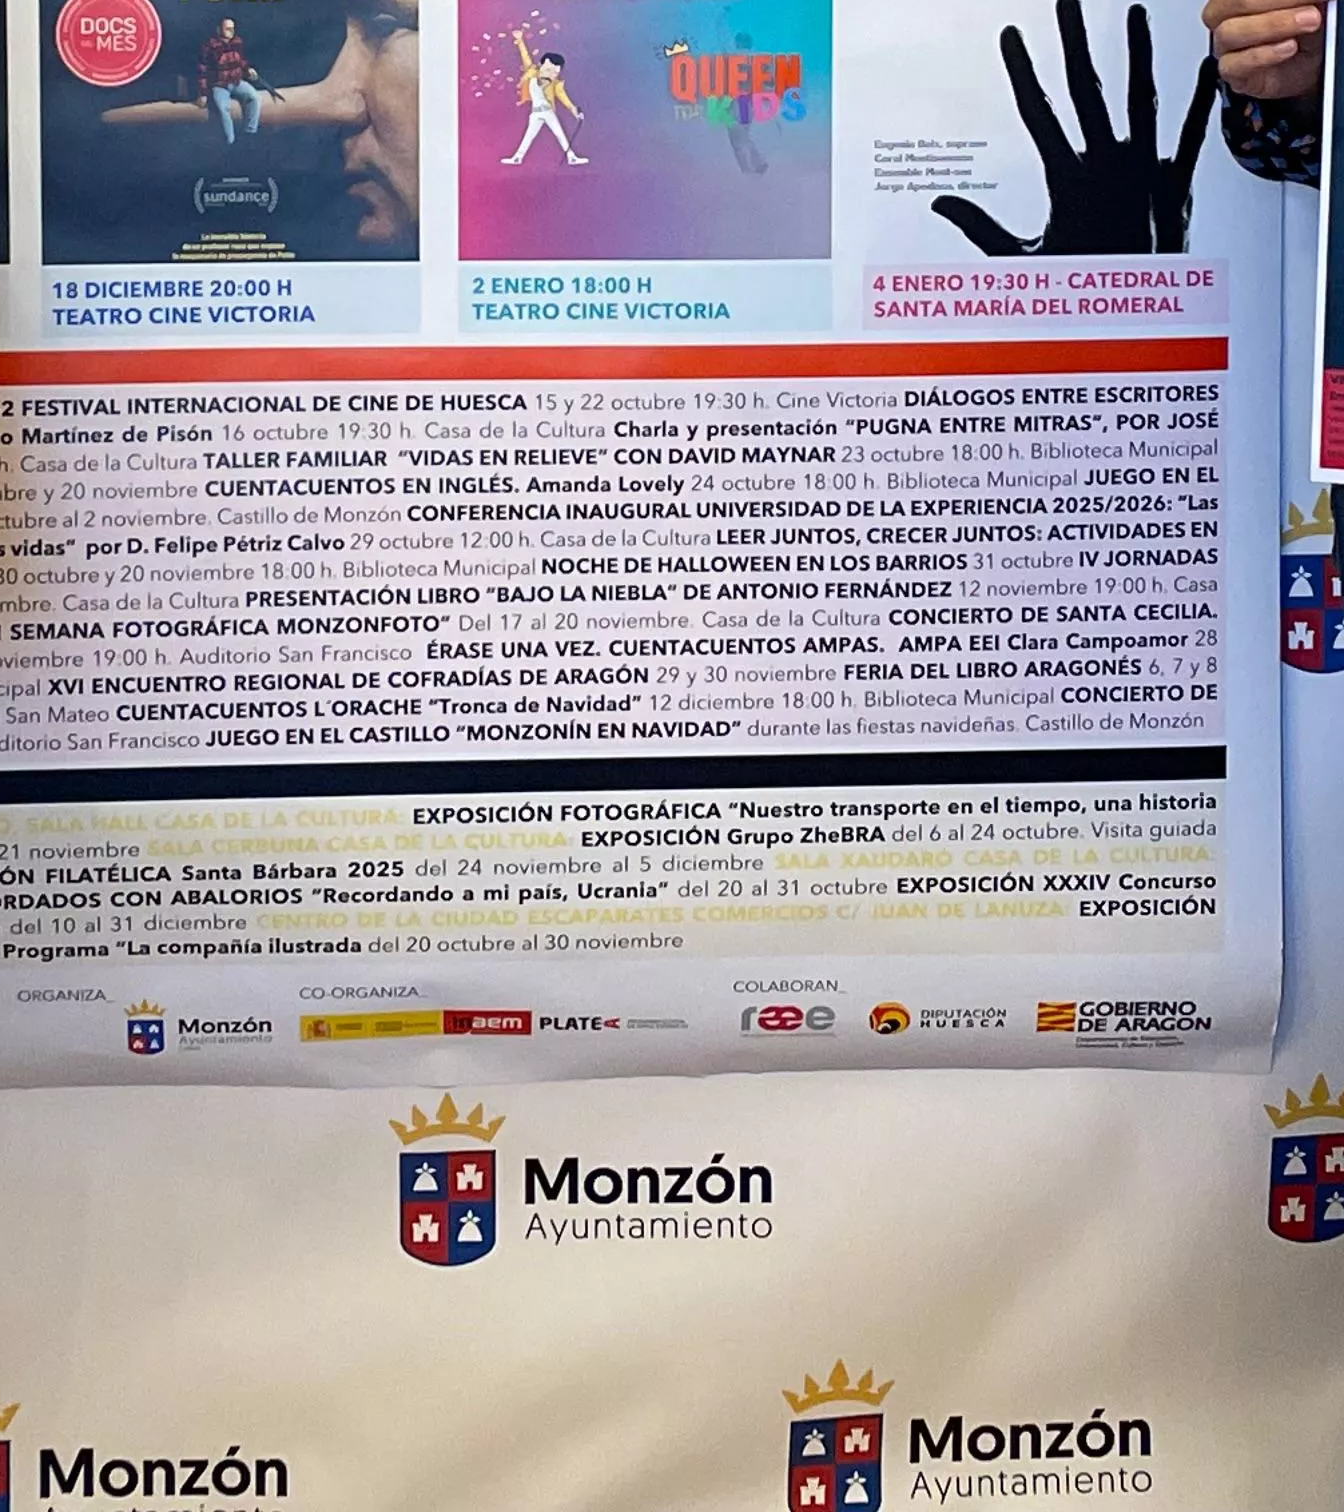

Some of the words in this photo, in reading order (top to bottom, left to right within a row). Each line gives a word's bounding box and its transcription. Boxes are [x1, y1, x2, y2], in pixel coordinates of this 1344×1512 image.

[204, 191, 269, 202] sundance
[874, 276, 885, 291] 4
[893, 275, 962, 291] ENERO
[972, 274, 1028, 290] 19:30
[1036, 274, 1048, 288] H
[1068, 271, 1179, 288] CATEDRAL
[1187, 270, 1213, 286] DE
[875, 301, 947, 317] SANTA
[955, 298, 1025, 316] MARÍA
[1033, 299, 1072, 314] DEL
[1079, 297, 1184, 314] ROMERAL
[22, 399, 120, 416] FESTIVAL
[128, 397, 305, 414] INTERNACIONAL
[314, 396, 340, 411] DE
[349, 396, 397, 411] CINE
[406, 396, 433, 410] DE
[442, 395, 527, 410] HUESCA
[905, 386, 1014, 406] DIÁLOGOS
[1023, 387, 1088, 404] ENTRE
[1095, 384, 1219, 403] ESCRITORES
[615, 421, 678, 437] Charla
[688, 426, 698, 441] y
[707, 420, 836, 441] presentación
[614, 449, 661, 464] CON
[669, 448, 735, 464] DAVID
[743, 447, 835, 463] MAYNAR
[1032, 443, 1122, 459] Biblioteca
[1130, 438, 1217, 460] Municipal
[567, 503, 691, 519] INAUGURAL
[697, 501, 840, 518] UNIVERSIDAD
[847, 501, 874, 516] DE
[881, 501, 905, 516] LA
[911, 498, 1048, 516] EXPERIENCIA
[1053, 496, 1172, 513] 2025/2026:
[542, 558, 618, 574] NOCHE
[625, 558, 651, 573] DE
[659, 556, 790, 572] HALLOWEEN
[797, 556, 824, 571] EN
[831, 556, 870, 571] LOS
[877, 554, 967, 570] BARRIOS
[889, 608, 1012, 625] CONCIERTO
[1022, 607, 1048, 623] DE
[1057, 605, 1126, 622] SANTA
[1134, 603, 1217, 620] CECILIA.
[845, 664, 903, 680] FERIA
[911, 663, 949, 679] DEL
[957, 662, 1017, 678] LIBRO
[1025, 655, 1141, 677] ARAGONÉS
[1026, 714, 1093, 731] Castillo
[1100, 713, 1123, 729] de
[1130, 713, 1203, 728] Monzón
[47, 864, 171, 883] FILATÉLICA
[183, 866, 241, 880] Santa
[254, 863, 336, 879] Bárbara
[349, 862, 403, 877] 2025
[1077, 1000, 1196, 1019] GOBIERNO
[179, 1017, 271, 1034] Monzón
[920, 1018, 1007, 1029] HUESCA
[1074, 1016, 1106, 1032] DE
[525, 1153, 771, 1204] Monzón
[526, 1212, 772, 1245] Ayuntamiento
[910, 1409, 1150, 1463] Monzón
[40, 1446, 287, 1498] Monzón
[911, 1467, 1152, 1504] Ayuntamiento
